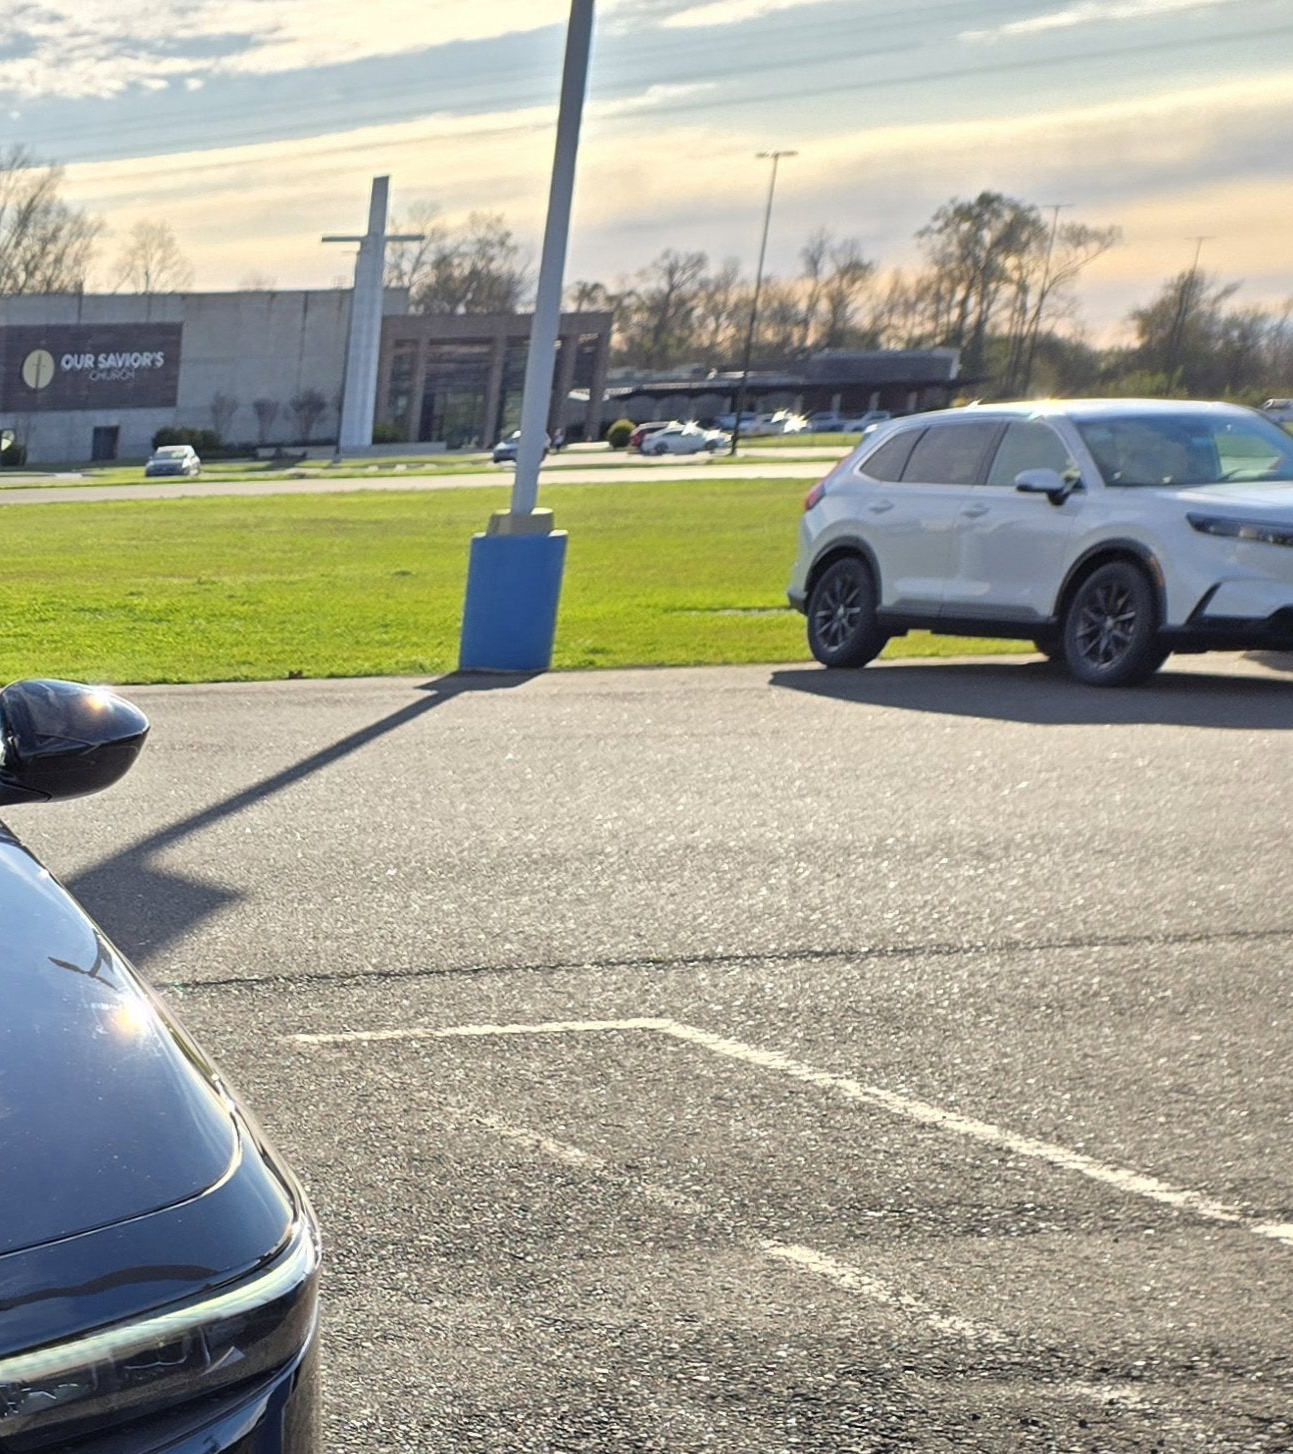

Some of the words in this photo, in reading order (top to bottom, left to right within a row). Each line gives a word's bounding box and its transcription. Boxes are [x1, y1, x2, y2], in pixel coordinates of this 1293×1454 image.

[61, 353, 95, 370] OUR
[98, 351, 165, 369] SAVIOR'S
[89, 368, 136, 381] CHURCH
